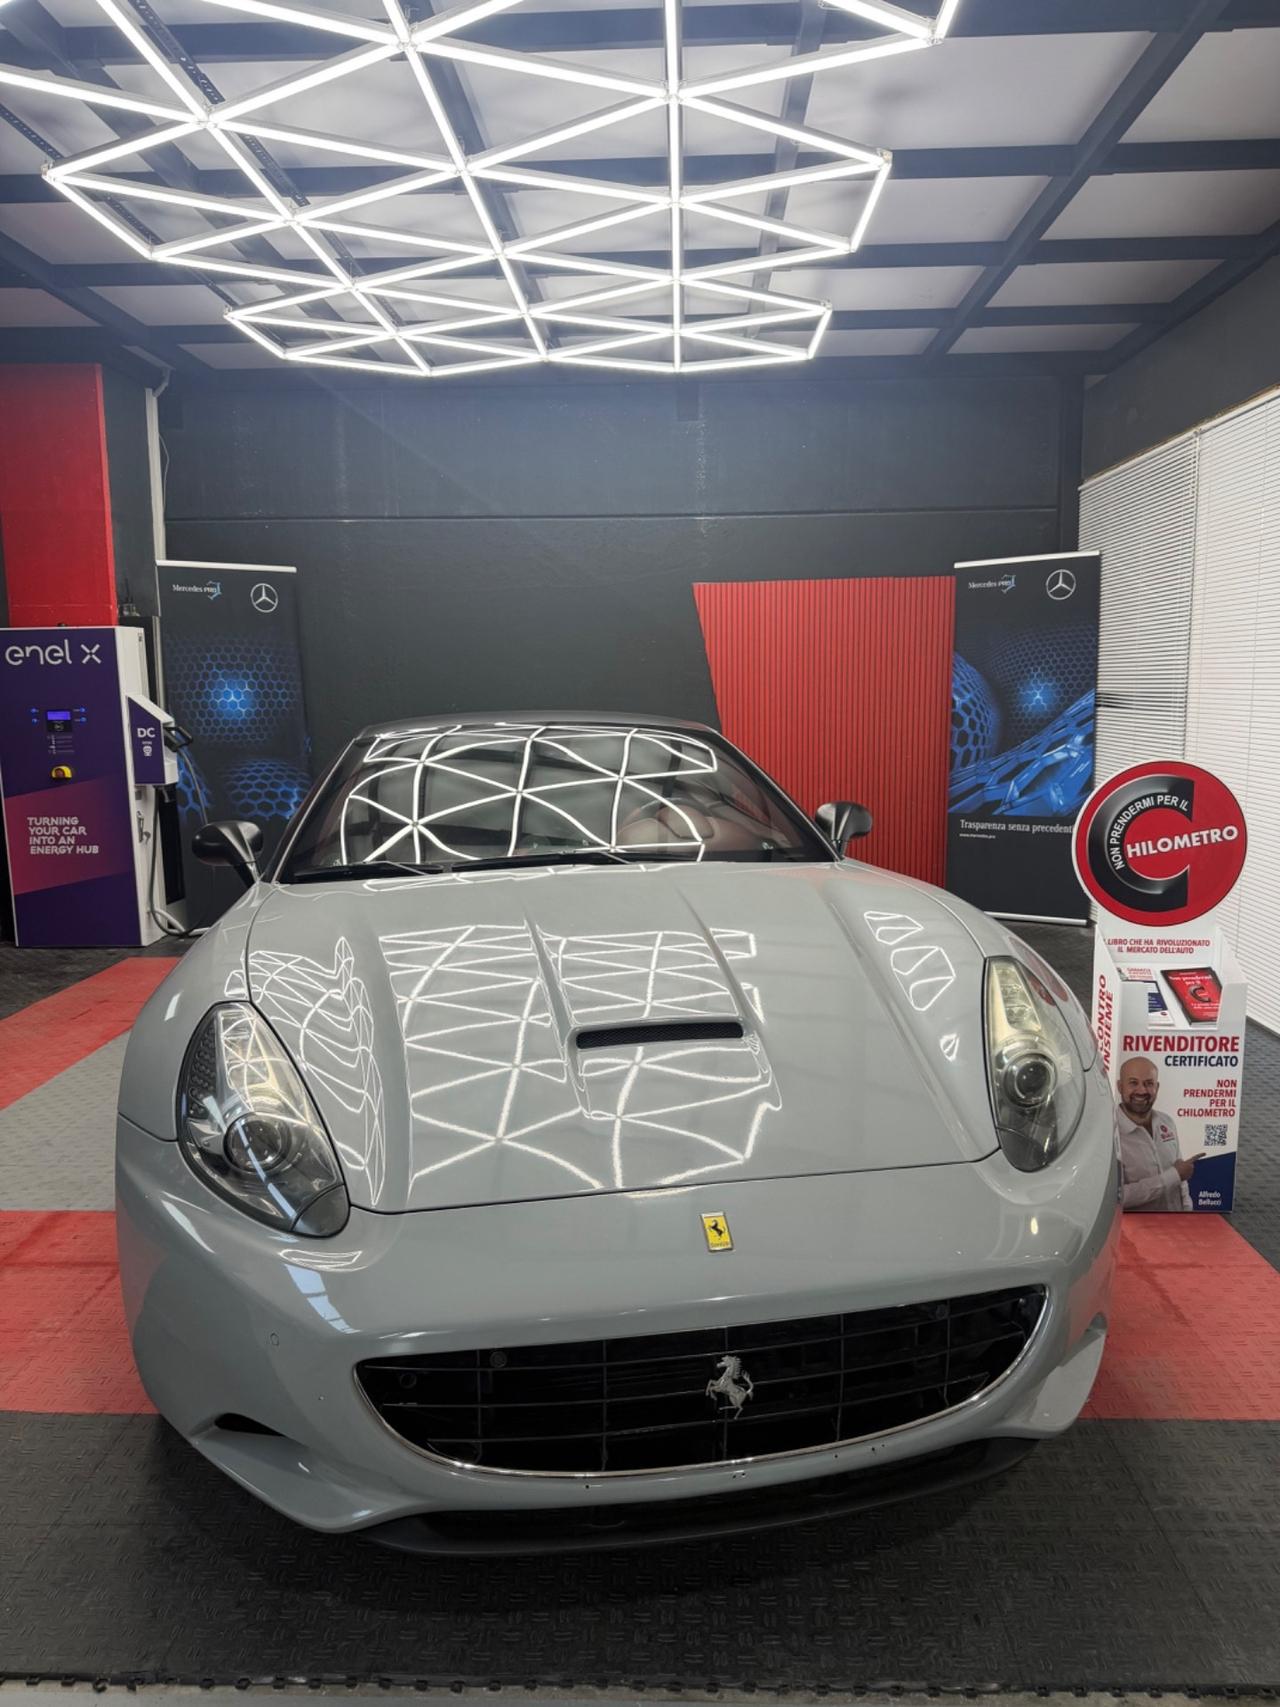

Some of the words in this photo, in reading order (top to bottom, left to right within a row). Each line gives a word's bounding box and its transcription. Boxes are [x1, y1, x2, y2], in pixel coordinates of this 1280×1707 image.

[5, 638, 72, 666] enel
[137, 728, 156, 738] DC
[1157, 795, 1178, 806] PER
[1179, 799, 1189, 812] IL
[27, 817, 79, 826] TURNING
[1110, 796, 1154, 844] PRENDERMI
[28, 826, 60, 836] YOUR
[62, 826, 87, 836] CAR
[960, 820, 1006, 831] Trasparenza
[1008, 824, 1030, 832] senza
[29, 836, 55, 844] INTO
[58, 836, 75, 844] AN
[30, 846, 73, 855] ENERGY
[76, 846, 99, 854] HUB
[1110, 848, 1125, 870] NON
[1123, 1035, 1240, 1052] RIVENDITORE
[1165, 1055, 1238, 1067] CERTIFICATO
[1217, 1080, 1237, 1088] NON
[1184, 1089, 1236, 1097] PRENDERMI
[1210, 1099, 1226, 1107] PER
[1229, 1099, 1236, 1107] IL
[1177, 1108, 1235, 1117] CHILOMETRO
